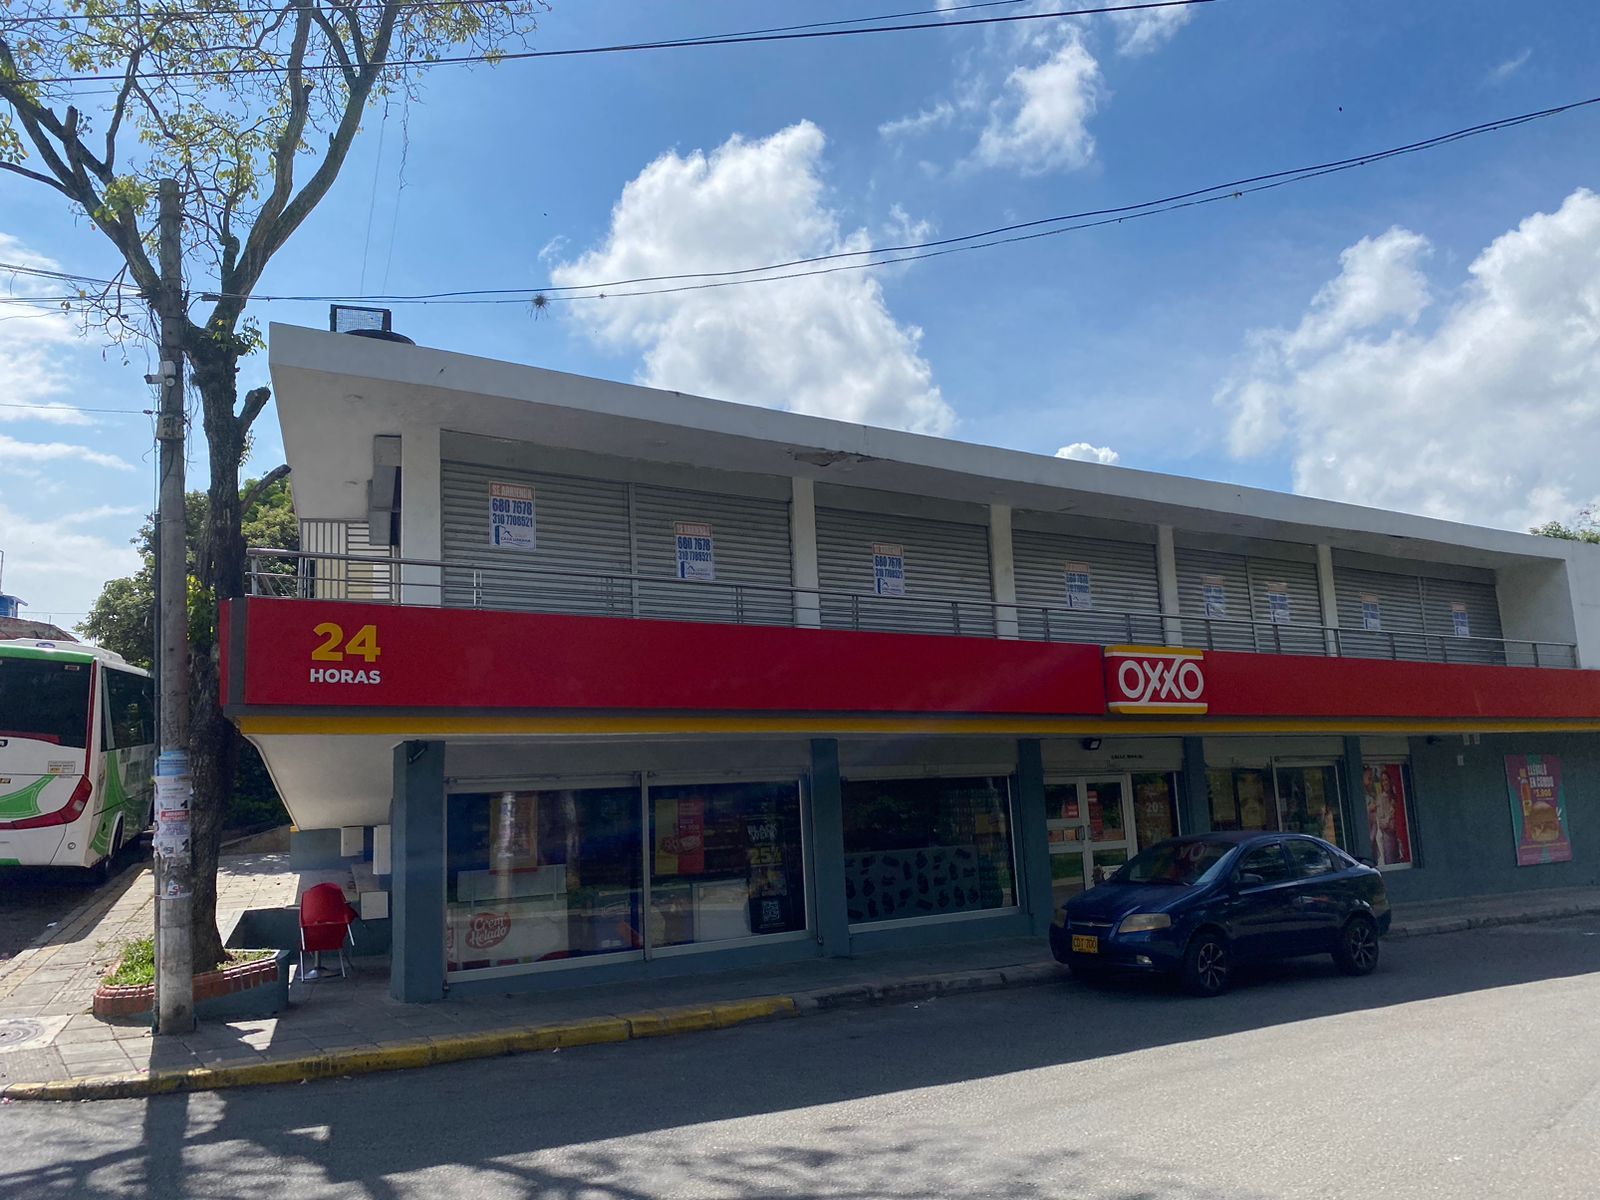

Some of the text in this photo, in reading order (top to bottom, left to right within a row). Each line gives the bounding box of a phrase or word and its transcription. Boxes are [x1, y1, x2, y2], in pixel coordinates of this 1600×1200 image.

[492, 498, 533, 516] 680 7678
[492, 512, 533, 528] 310 7708521
[677, 536, 711, 551] 680 7678
[311, 622, 381, 663] 24
[309, 668, 382, 684] HORAS
[1118, 657, 1205, 703] OXXO
[474, 917, 505, 932] Crem
[470, 926, 507, 946] Helado
